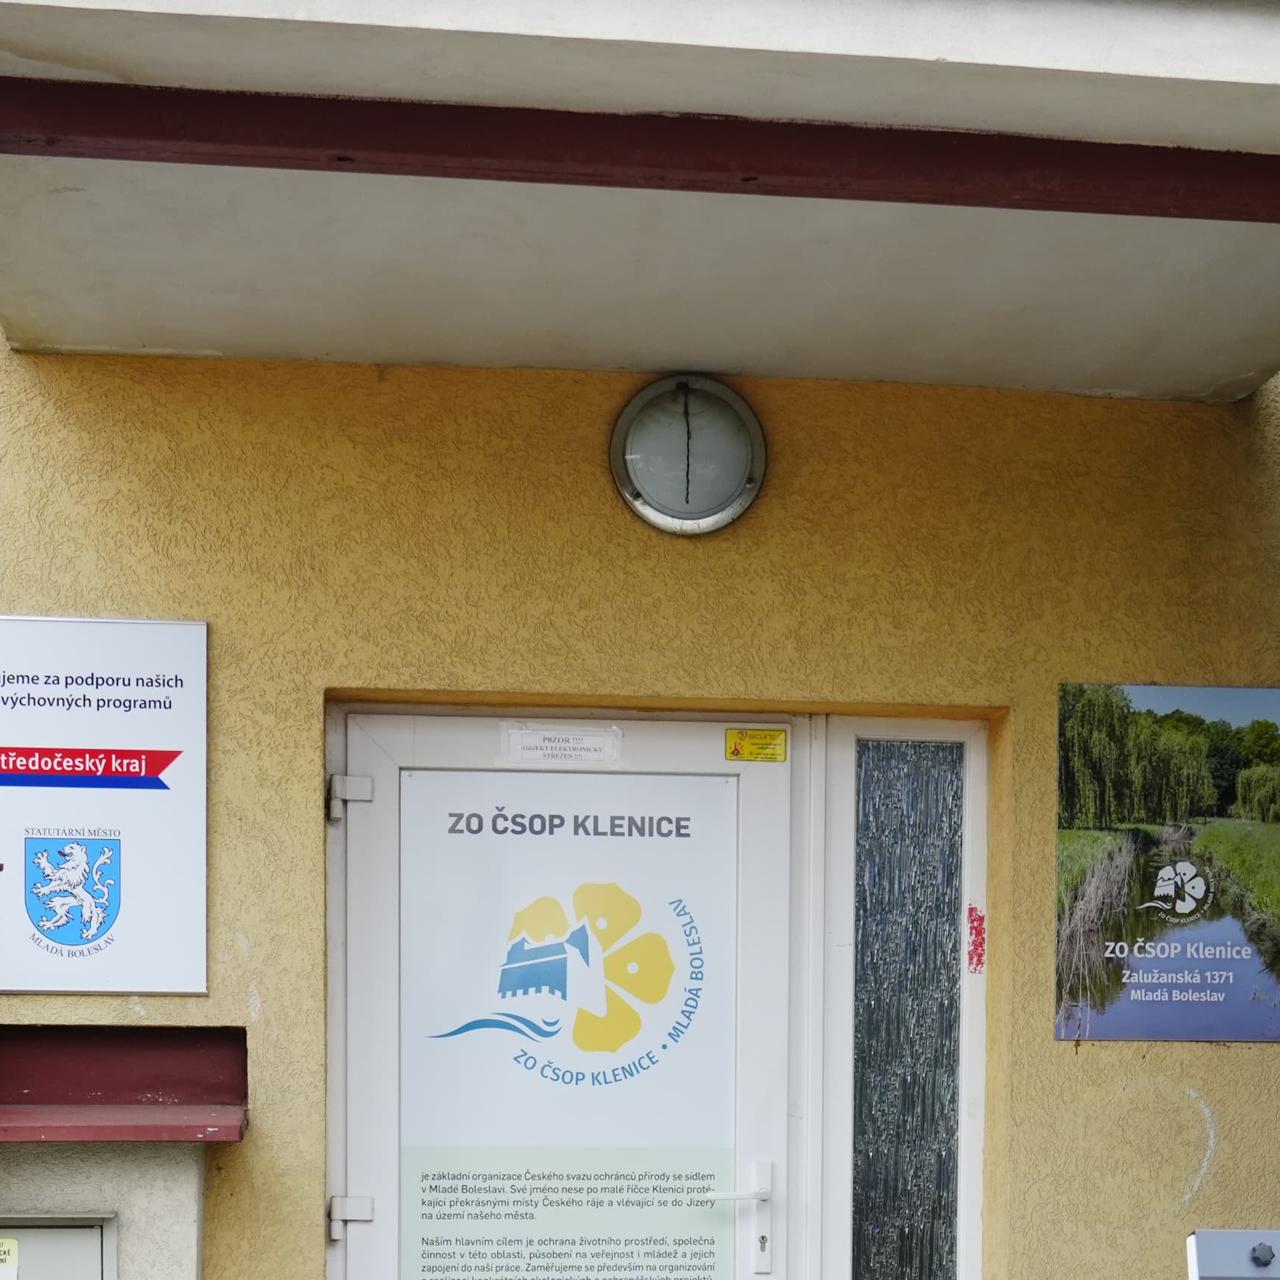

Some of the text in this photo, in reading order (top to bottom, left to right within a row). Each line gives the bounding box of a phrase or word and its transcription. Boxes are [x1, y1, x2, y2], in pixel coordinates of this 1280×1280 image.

[44, 674, 60, 685] za
[65, 672, 131, 689] podporu
[136, 674, 183, 688] našich
[96, 696, 172, 712] programů
[112, 755, 146, 775] kraj
[448, 806, 691, 837] ZO ČSOP KLENICE
[24, 828, 120, 837] STATUTÁRNÍ MĚSTO
[28, 932, 116, 958] MLADÁ BOLESLAV
[1104, 938, 1252, 959] ZO ČSOP Klenice
[1122, 969, 1234, 984] Zalužanská 1371
[512, 898, 704, 1086] ZO ČSOP KLENICE MLADÁ BOLESLAV
[1131, 988, 1226, 1002] Mladá Boleslav
[421, 1170, 715, 1183] je základní organizace Českého svazu ochránců přírody se sídlem
[429, 1184, 459, 1194] Mladé
[510, 1184, 527, 1194] Své
[529, 1184, 559, 1196] jméno
[561, 1186, 584, 1194] nese
[586, 1186, 598, 1196] po
[600, 1185, 624, 1194] malé
[627, 1184, 650, 1194] říčce
[652, 1185, 684, 1194] Klenici
[421, 1197, 447, 1209] kající
[449, 1197, 509, 1209] překrásnými
[512, 1198, 539, 1209] místy
[542, 1196, 583, 1207] Českého
[586, 1198, 604, 1209] ráje
[616, 1197, 655, 1209] vlévající
[671, 1198, 683, 1207] do
[686, 1198, 716, 1209] Jizery
[421, 1212, 433, 1220] na
[435, 1210, 465, 1220] území
[467, 1210, 502, 1220] našeho
[421, 1236, 452, 1247] Naším
[455, 1236, 493, 1246] hlavním
[496, 1237, 523, 1246] cílem
[526, 1237, 535, 1248] je
[537, 1237, 576, 1246] ochrana
[579, 1236, 622, 1246] životního
[672, 1236, 715, 1247] společná
[421, 1249, 456, 1260] činnost
[468, 1250, 488, 1259] této
[529, 1249, 573, 1261] působení
[590, 1249, 634, 1261] veřejnost
[643, 1249, 678, 1259] mládež
[690, 1249, 715, 1261] jejich
[421, 1263, 460, 1274] zapojení
[461, 1263, 473, 1273] do
[474, 1263, 493, 1272] naší
[525, 1262, 583, 1274] Zaměřujeme
[597, 1262, 644, 1273] především
[646, 1264, 657, 1272] na
[658, 1262, 716, 1274] organizování
